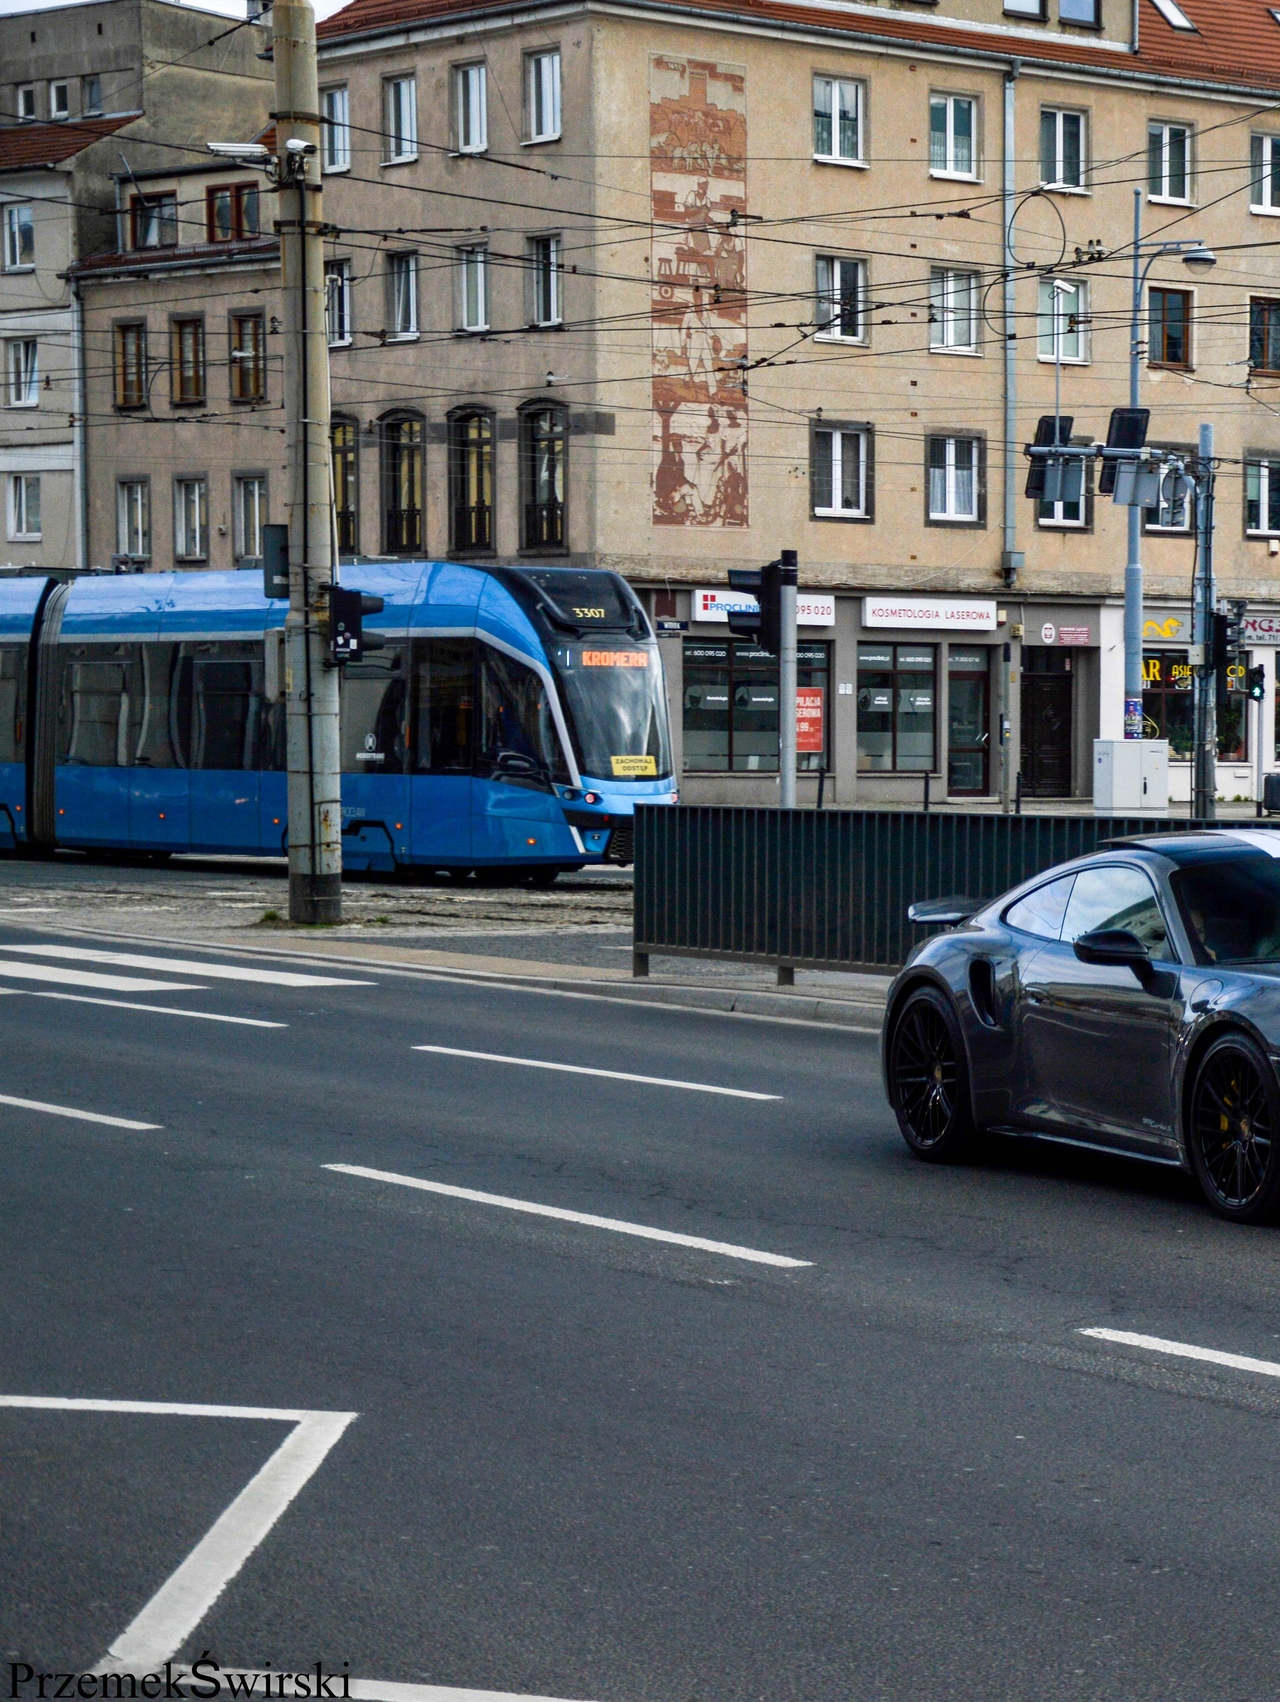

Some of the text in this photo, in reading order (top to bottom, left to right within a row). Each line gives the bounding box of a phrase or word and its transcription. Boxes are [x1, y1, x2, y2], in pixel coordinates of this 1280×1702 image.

[709, 603, 761, 612] PROCLINI
[814, 606, 832, 615] 020
[572, 608, 605, 618] 3307
[871, 608, 991, 620] KOSMETOLOGIA LASEROWA
[582, 651, 648, 667] KROMERA
[796, 697, 821, 706] PILACJA
